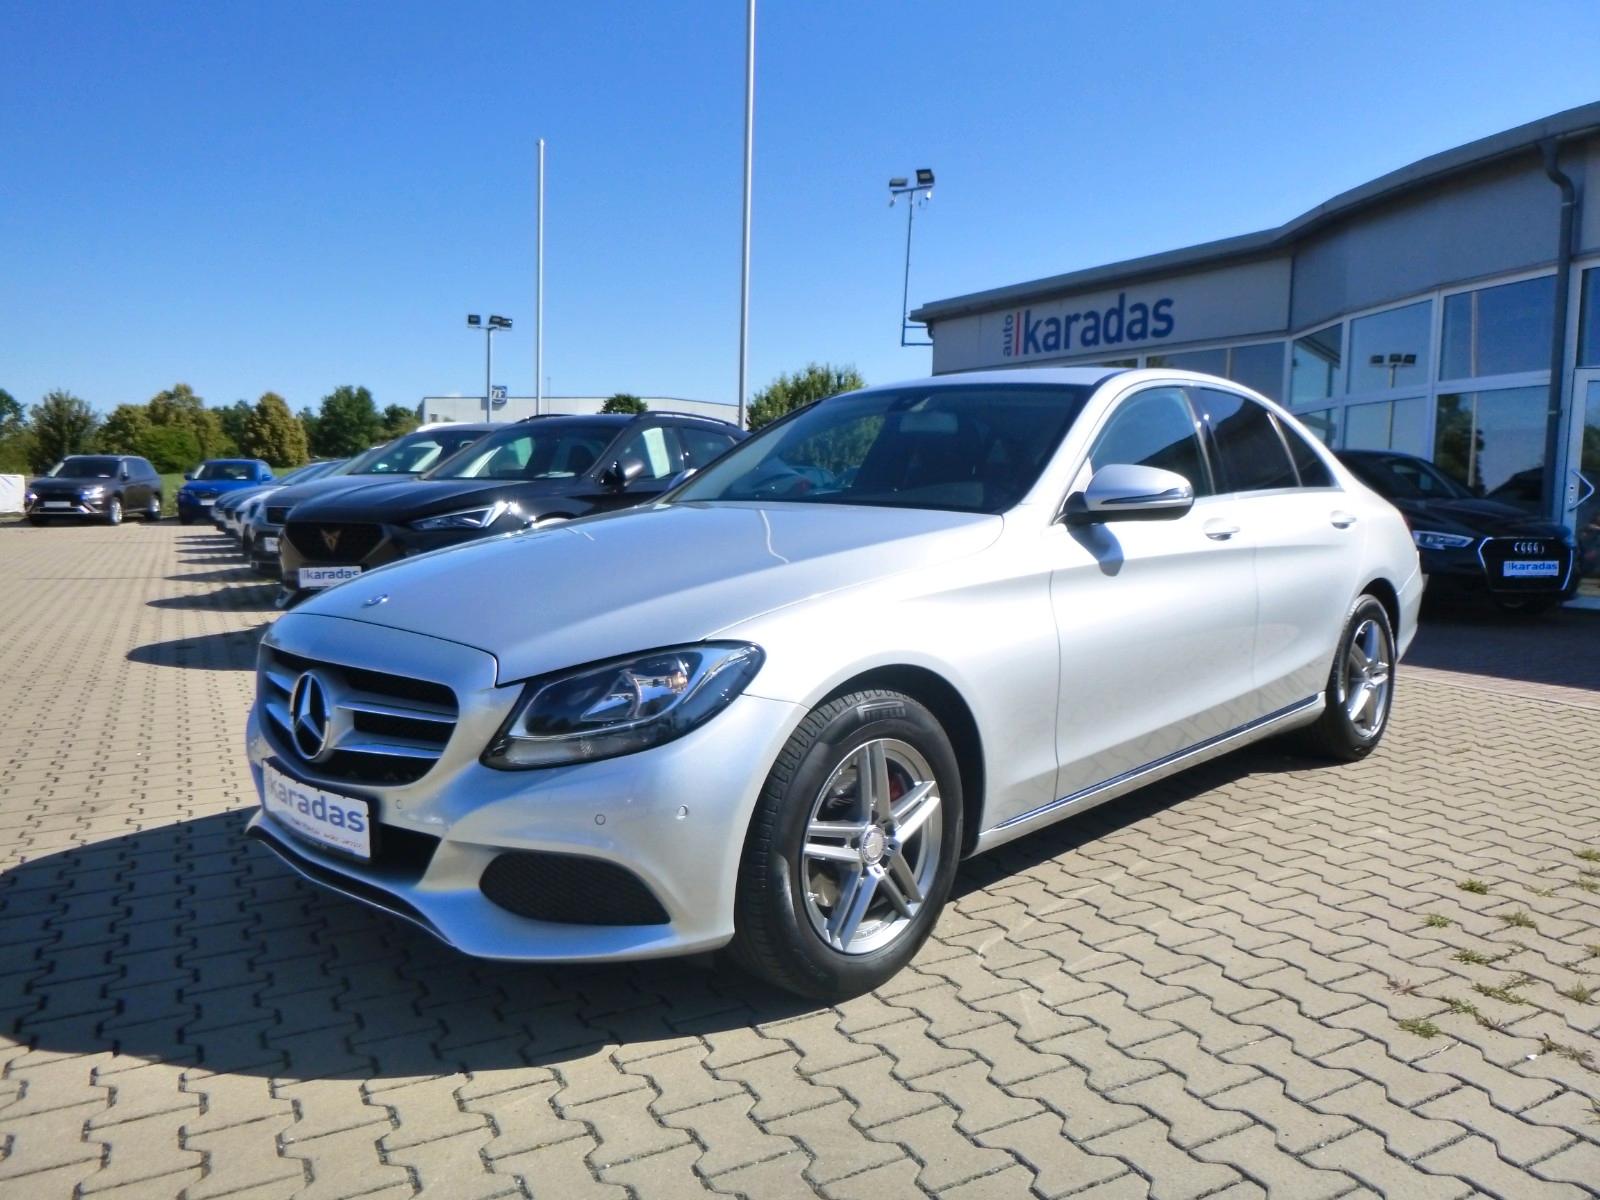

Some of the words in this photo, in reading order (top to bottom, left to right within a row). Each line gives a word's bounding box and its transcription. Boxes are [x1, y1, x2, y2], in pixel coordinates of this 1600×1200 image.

[1002, 314, 1013, 357] auto
[1023, 292, 1175, 355] karadas
[1511, 562, 1557, 570] karadas
[270, 776, 365, 832] karadas
